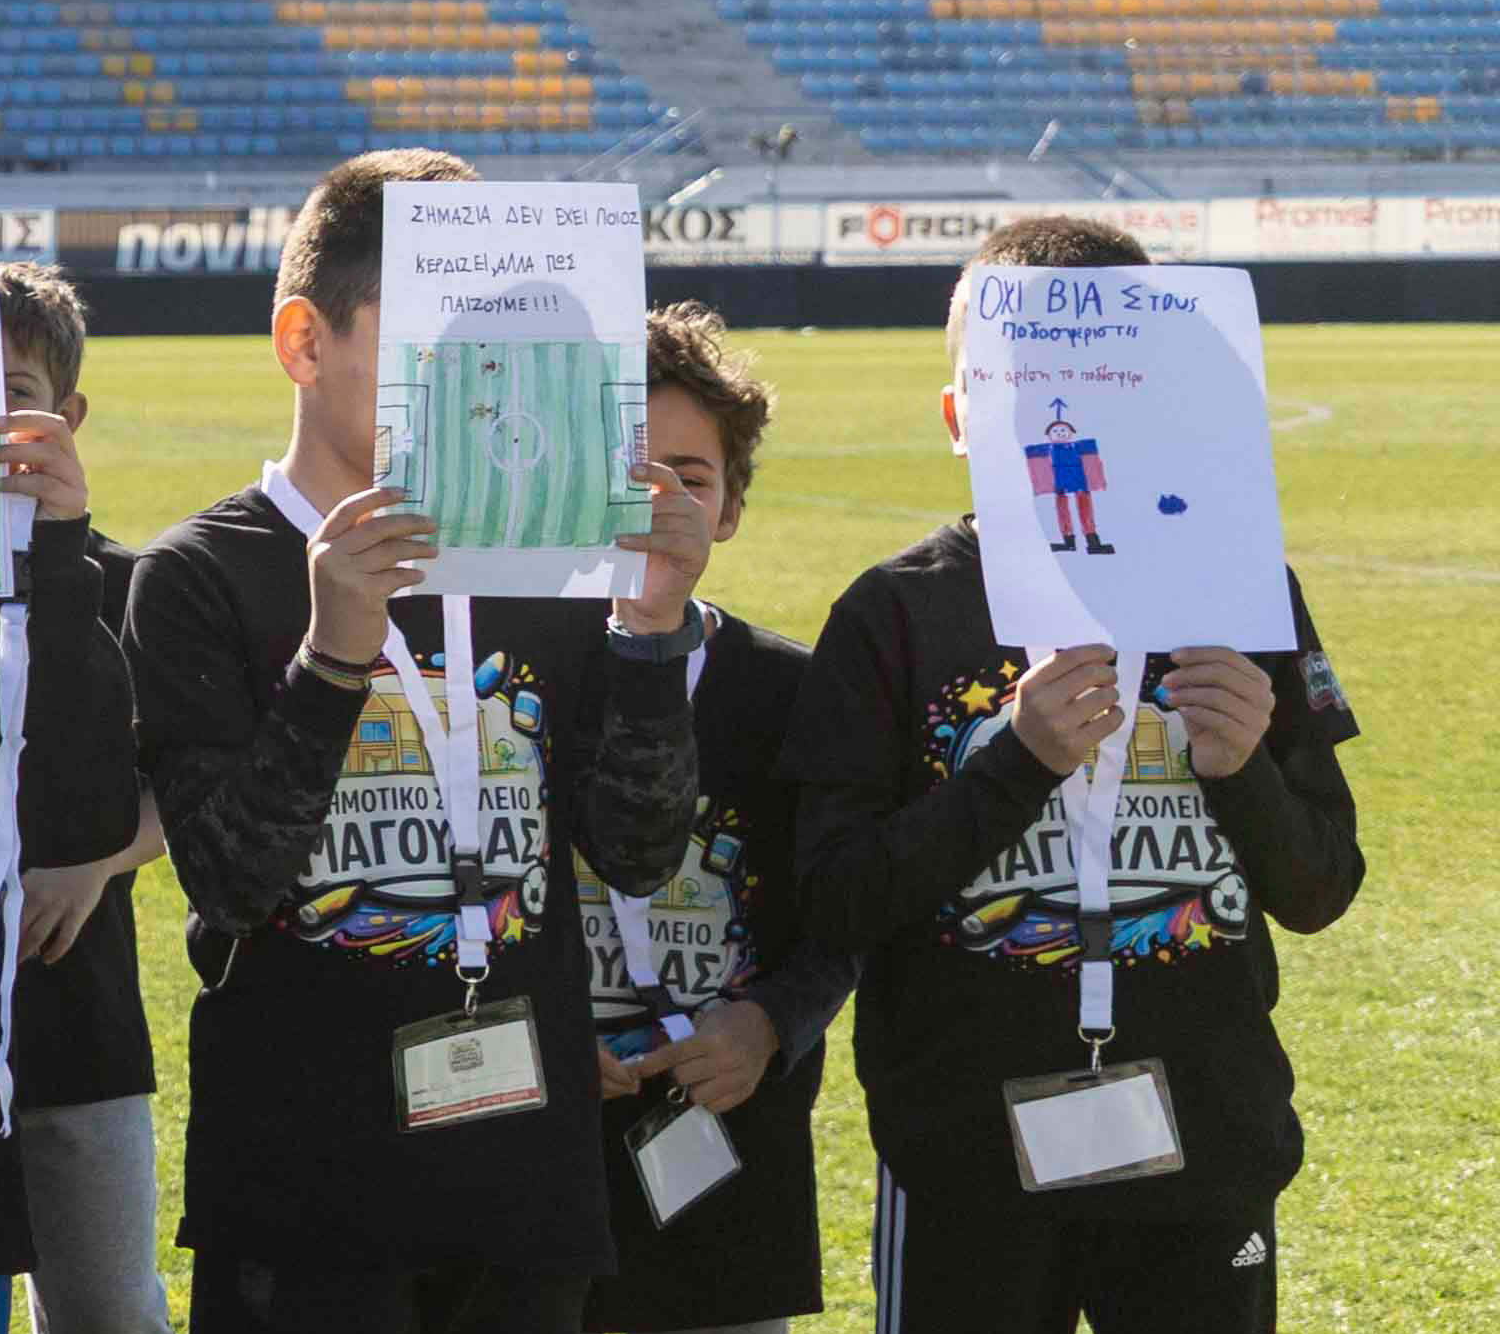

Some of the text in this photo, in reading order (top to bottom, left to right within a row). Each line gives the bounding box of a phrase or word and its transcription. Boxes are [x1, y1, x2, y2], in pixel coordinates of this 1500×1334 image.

[411, 205, 491, 225] ΣΗΜΑΣΙΑ
[505, 207, 543, 224] ΔΕΝ
[555, 207, 588, 225] ΕΧΕΙ
[979, 275, 1023, 320] ΟΧΙ
[1047, 278, 1102, 318] ΒΙΑ
[328, 786, 429, 816] ΗΜΟΤΙΚΟ
